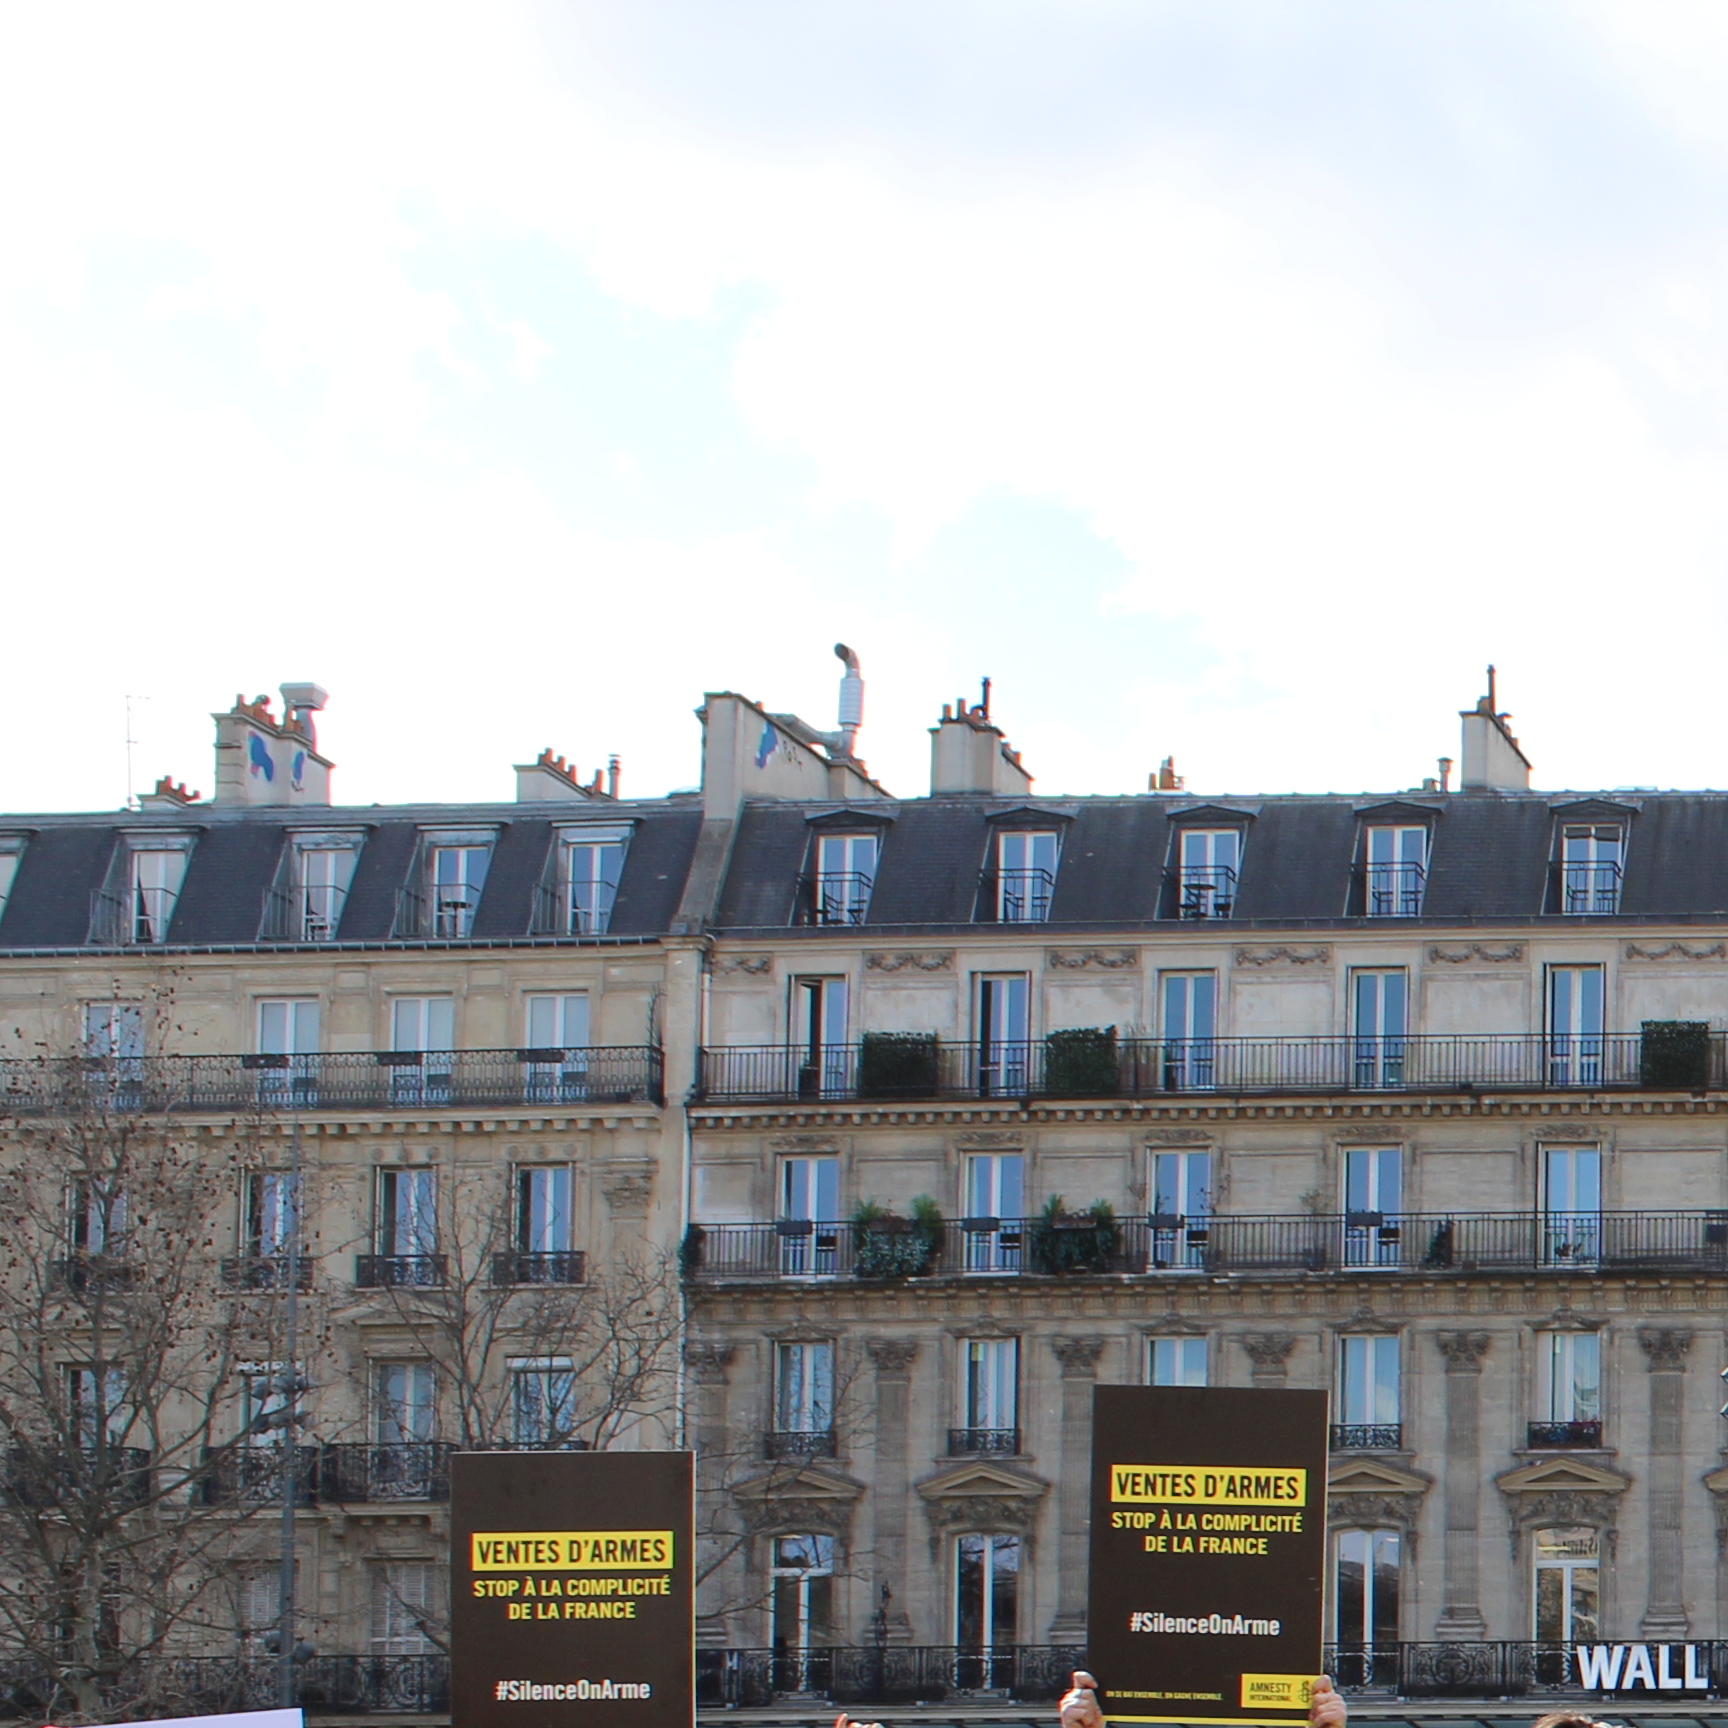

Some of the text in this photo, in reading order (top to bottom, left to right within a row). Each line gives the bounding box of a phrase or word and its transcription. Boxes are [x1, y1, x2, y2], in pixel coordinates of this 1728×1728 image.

[1116, 1472, 1298, 1500] VENTES D'ARMES
[1111, 1508, 1302, 1532] STOP À LA COMPLICITÉ
[477, 1538, 665, 1564] VENTES D'ARMES
[1144, 1535, 1268, 1555] DE LA FRANCE
[473, 1574, 670, 1597] STOP À LA COMPLICITÉ
[508, 1601, 635, 1619] DE LA FRANCE
[1129, 1611, 1280, 1635] #SilenceOnArme
[1576, 1644, 1709, 1690] WALL
[495, 1678, 650, 1700] #SilenceOnArme
[1249, 1682, 1291, 1693] AMNESTY
